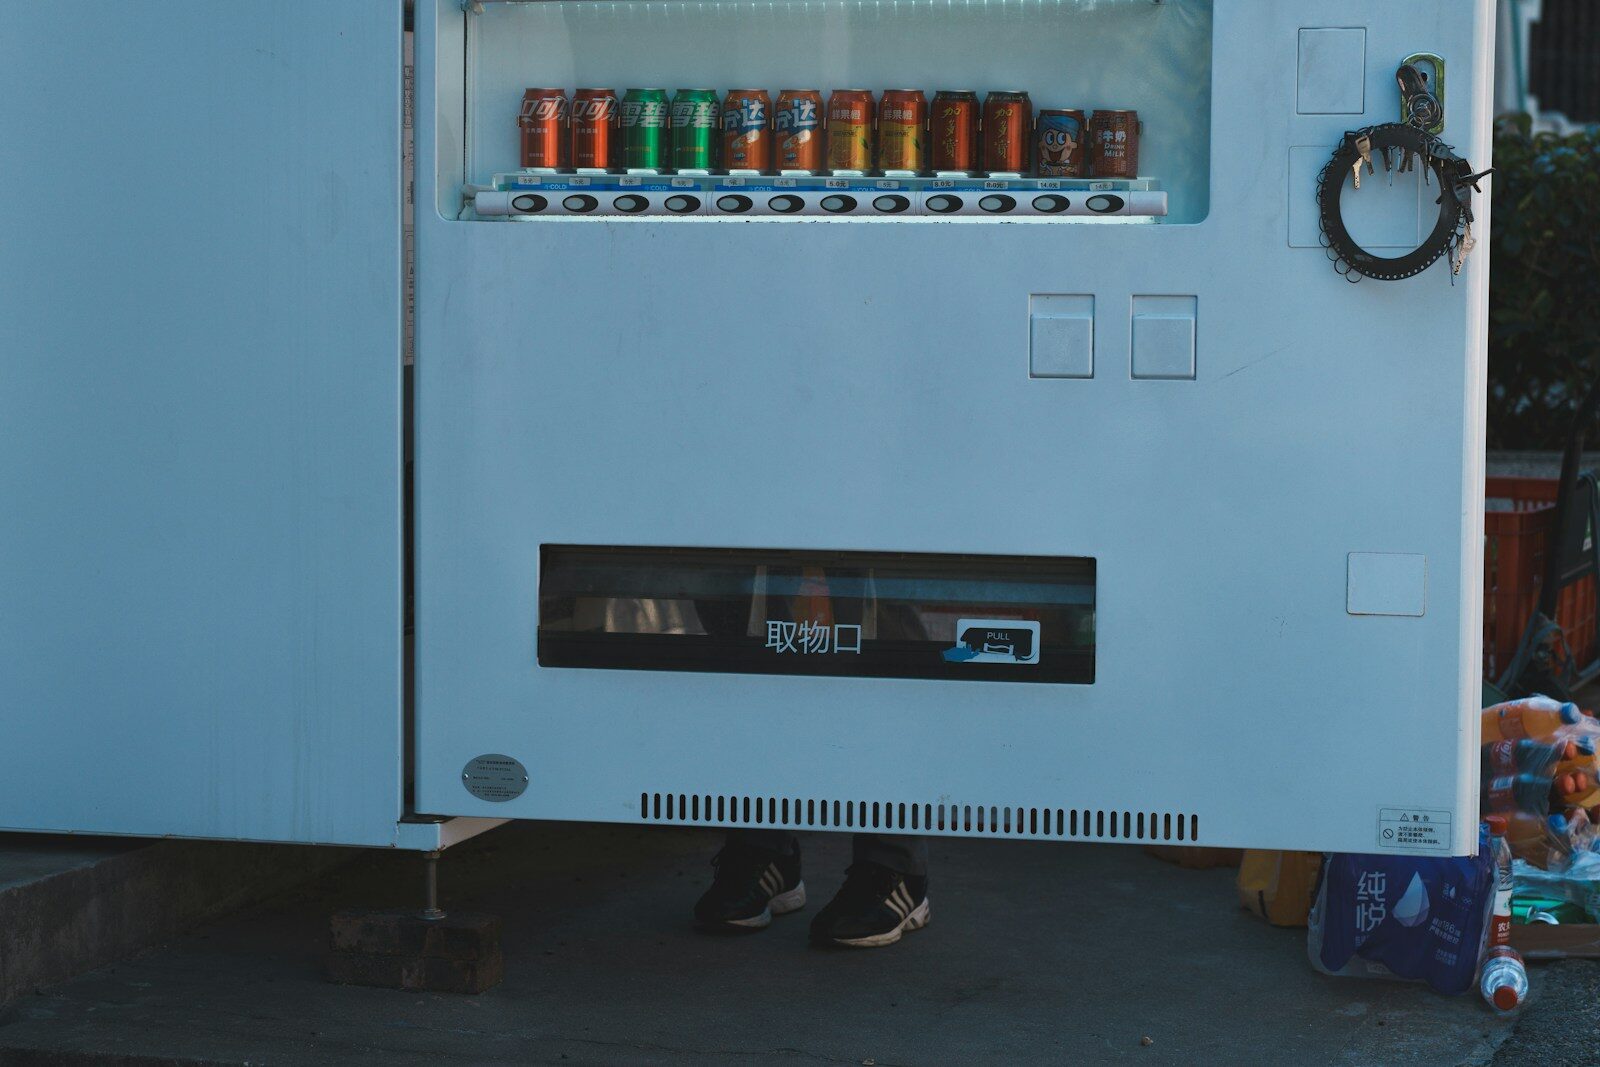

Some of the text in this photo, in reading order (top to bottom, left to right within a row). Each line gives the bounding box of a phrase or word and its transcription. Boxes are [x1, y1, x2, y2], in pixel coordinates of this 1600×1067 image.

[621, 102, 668, 128] 雪碧
[672, 102, 718, 128] 雪碧
[1104, 150, 1125, 158] MILK
[765, 620, 862, 655] 取物口
[986, 631, 1010, 641] PULL
[1356, 871, 1387, 932] 纯悦
